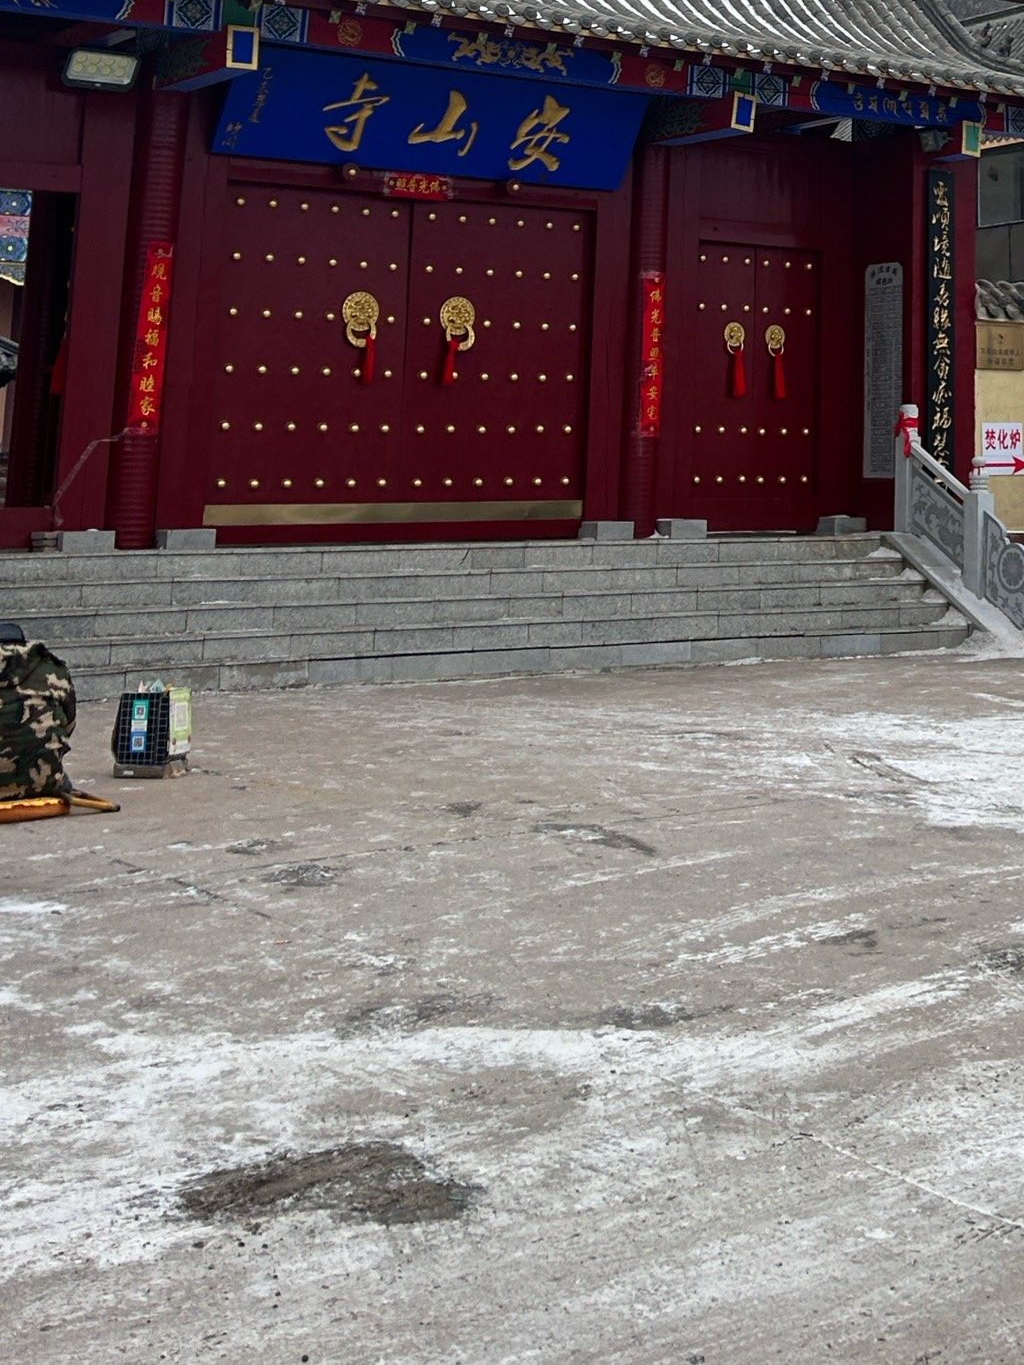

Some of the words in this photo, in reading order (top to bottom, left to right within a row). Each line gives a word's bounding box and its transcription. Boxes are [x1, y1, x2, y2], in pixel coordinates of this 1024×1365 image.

[394, 178, 441, 194] 佛光普照
[984, 428, 1021, 451] 焚化炉
